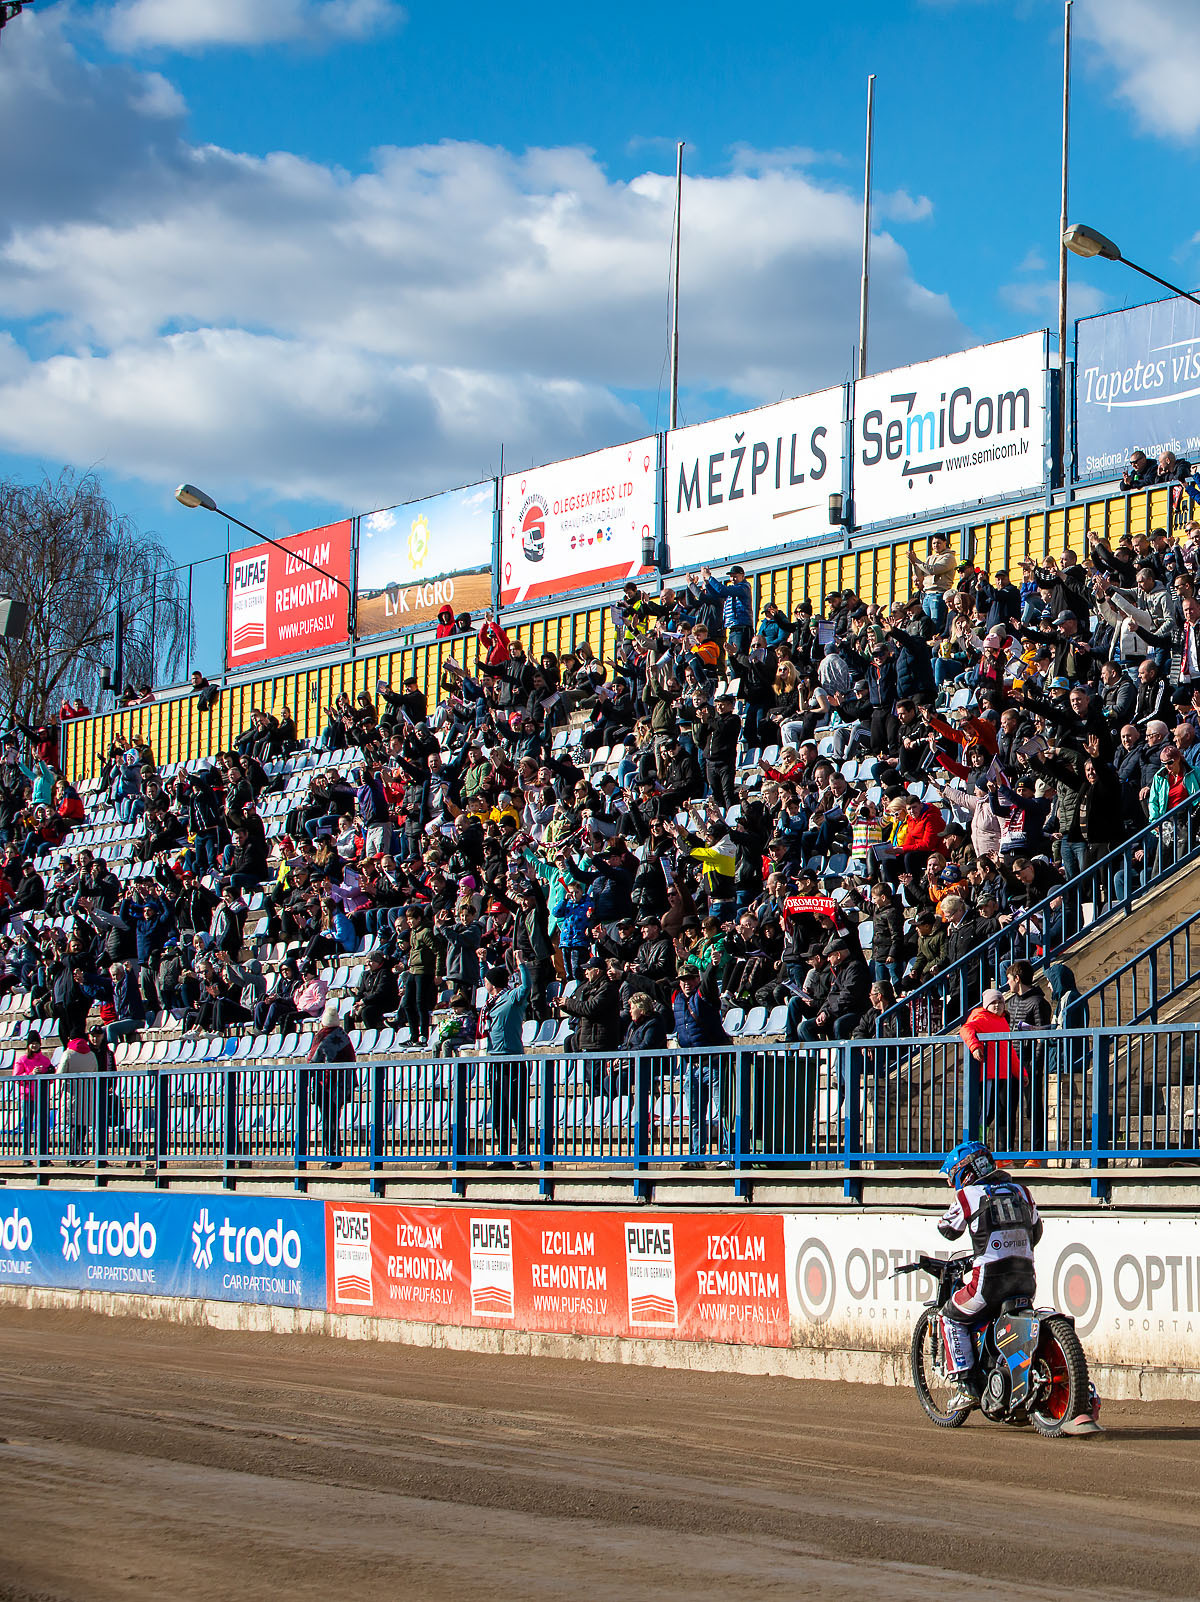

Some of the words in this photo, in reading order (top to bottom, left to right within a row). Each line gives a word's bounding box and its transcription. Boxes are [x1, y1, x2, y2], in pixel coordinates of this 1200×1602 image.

[1084, 357, 1167, 412] Tapetes
[863, 386, 1031, 466] SemiCom
[945, 438, 1030, 472] www.semicom.lv
[1086, 451, 1122, 471] Stadiona
[676, 426, 829, 514] MEŽPILS
[553, 485, 616, 516] OLEGSEXPRESS
[618, 482, 633, 499] LTD
[234, 560, 267, 591] PUFAS
[275, 575, 339, 613] REMONTAM
[384, 588, 411, 618] LVK
[414, 578, 455, 610] AGRO
[278, 614, 335, 641] WWW.PUFAS.LV
[992, 1198, 1017, 1221] 11
[84, 1211, 157, 1259] trodo
[336, 1215, 369, 1241] PUFAS
[396, 1223, 443, 1250] IZCILAM
[472, 1223, 510, 1249] PUFAS
[627, 1228, 671, 1255] PUFAS
[219, 1217, 302, 1269] trodo
[541, 1231, 595, 1256] IZCILAM
[707, 1235, 766, 1262] IZCILAM
[87, 1265, 103, 1280] CAR
[103, 1267, 128, 1282] PARTS
[128, 1268, 156, 1284] ONLINE
[387, 1255, 453, 1282] REMONTAM
[531, 1264, 607, 1291] REMONTAM
[629, 1266, 643, 1278] MADE
[650, 1267, 673, 1280] GERMANY
[846, 1247, 967, 1303] OPTIB
[223, 1273, 243, 1290] CAR
[243, 1275, 272, 1293] PARTS
[271, 1277, 302, 1296] ONLINE
[389, 1284, 453, 1305] WWW.PUFAS.LV
[696, 1270, 780, 1299] REMONTAM
[533, 1295, 607, 1315] WWW.PUFAS.LV
[698, 1302, 780, 1324] WWW.PUFAS.LV
[847, 1306, 912, 1321] SPORTA
[1114, 1317, 1194, 1334] SPORTA
